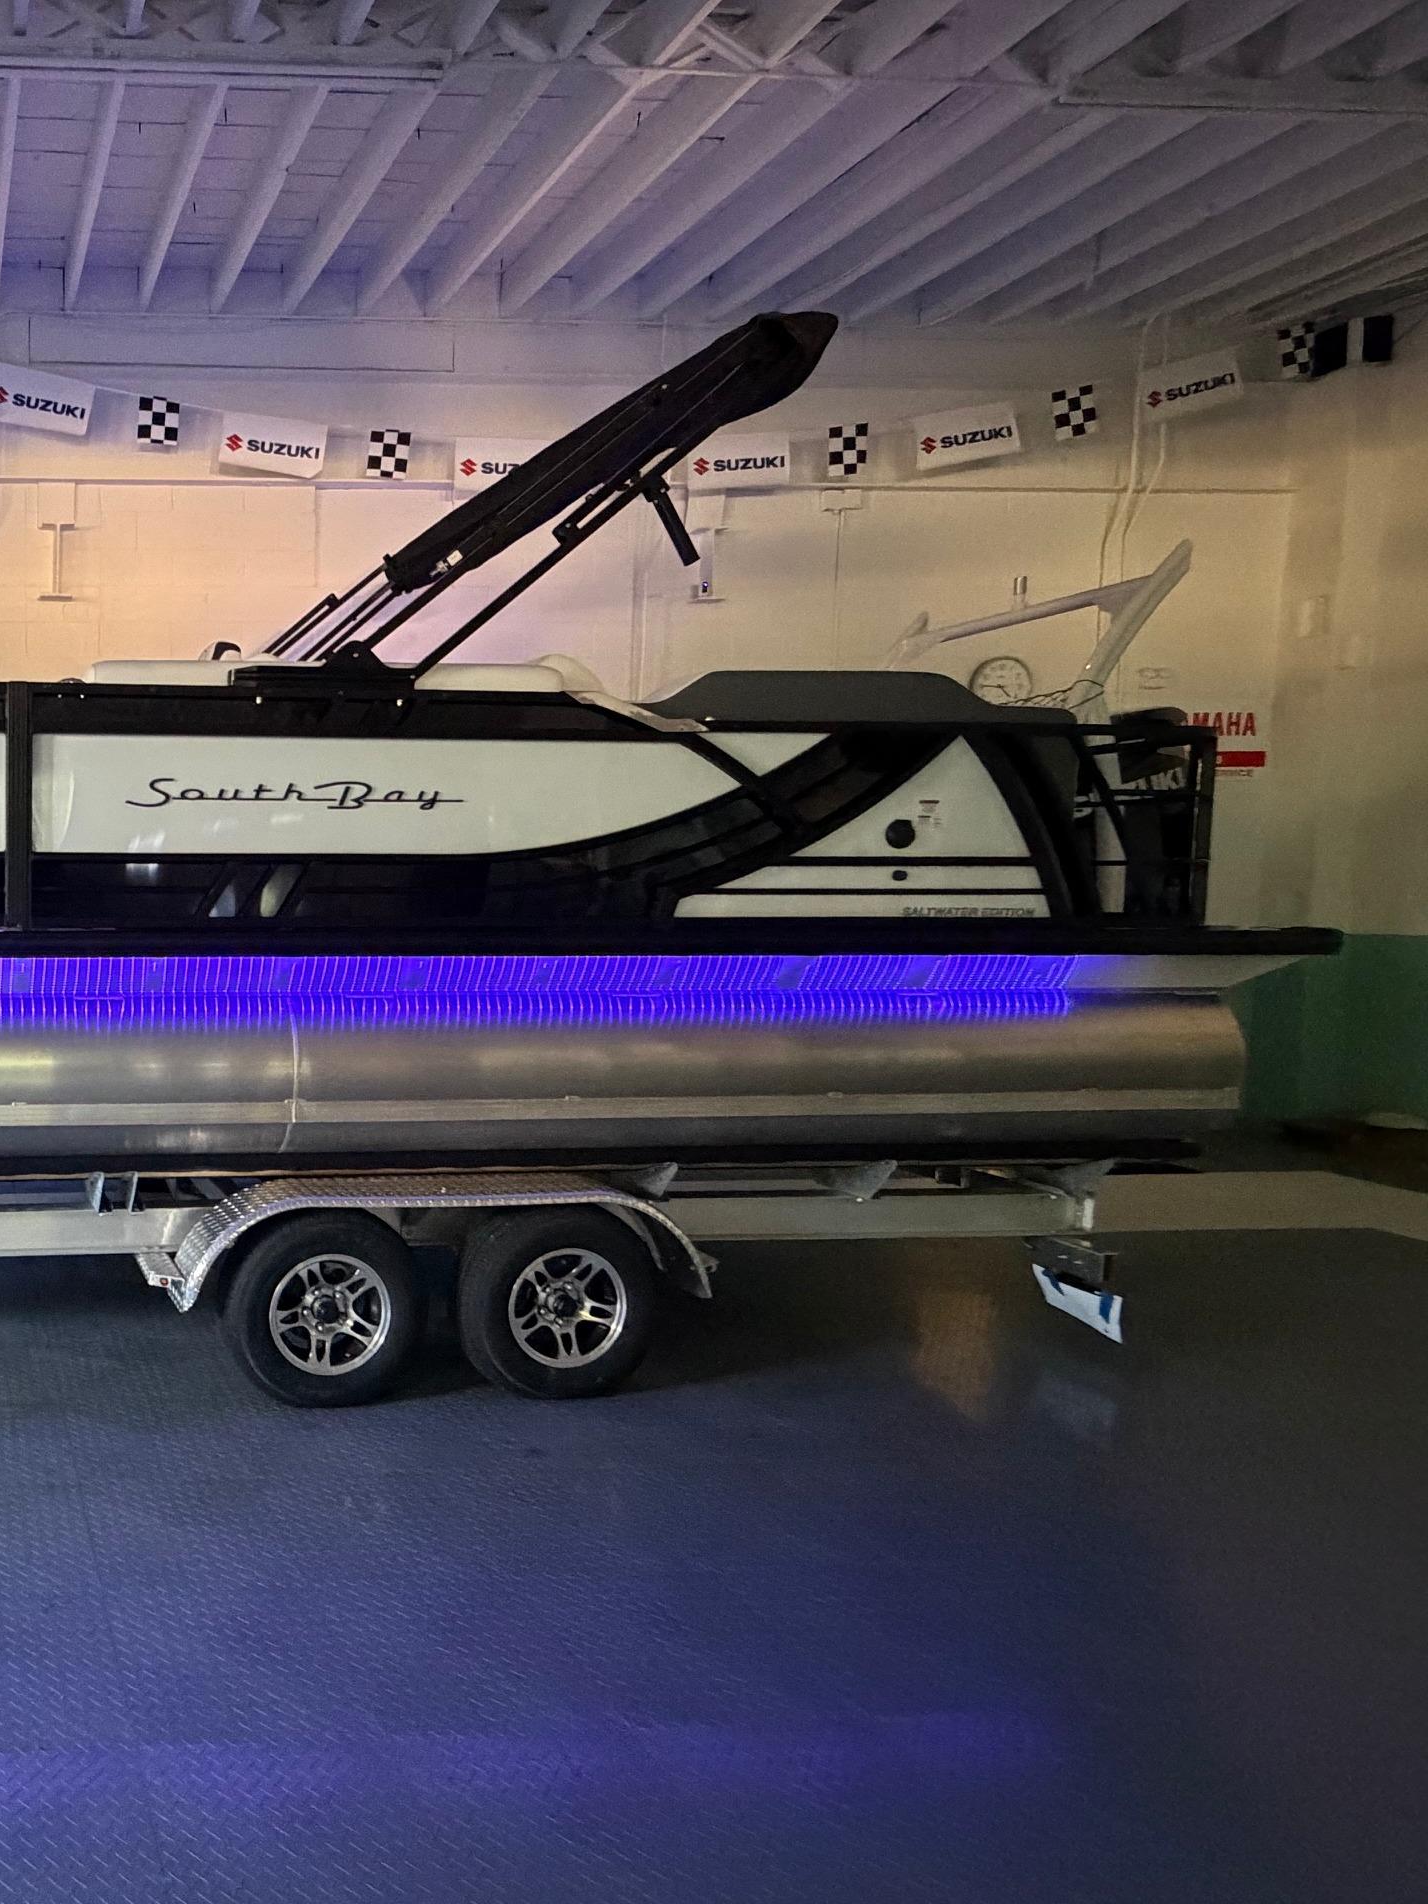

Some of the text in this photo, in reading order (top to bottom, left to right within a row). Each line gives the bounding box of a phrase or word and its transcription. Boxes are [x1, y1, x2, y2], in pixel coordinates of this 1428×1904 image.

[1164, 371, 1236, 402] SUZUKI
[11, 392, 86, 420] SUZUKI
[246, 438, 321, 460] SUZUKI
[939, 425, 1014, 449] SUZUKI
[480, 460, 522, 476] SUZ
[712, 455, 786, 473] SUZUKI
[1185, 711, 1257, 737] MAHA
[125, 778, 464, 810] South Bay
